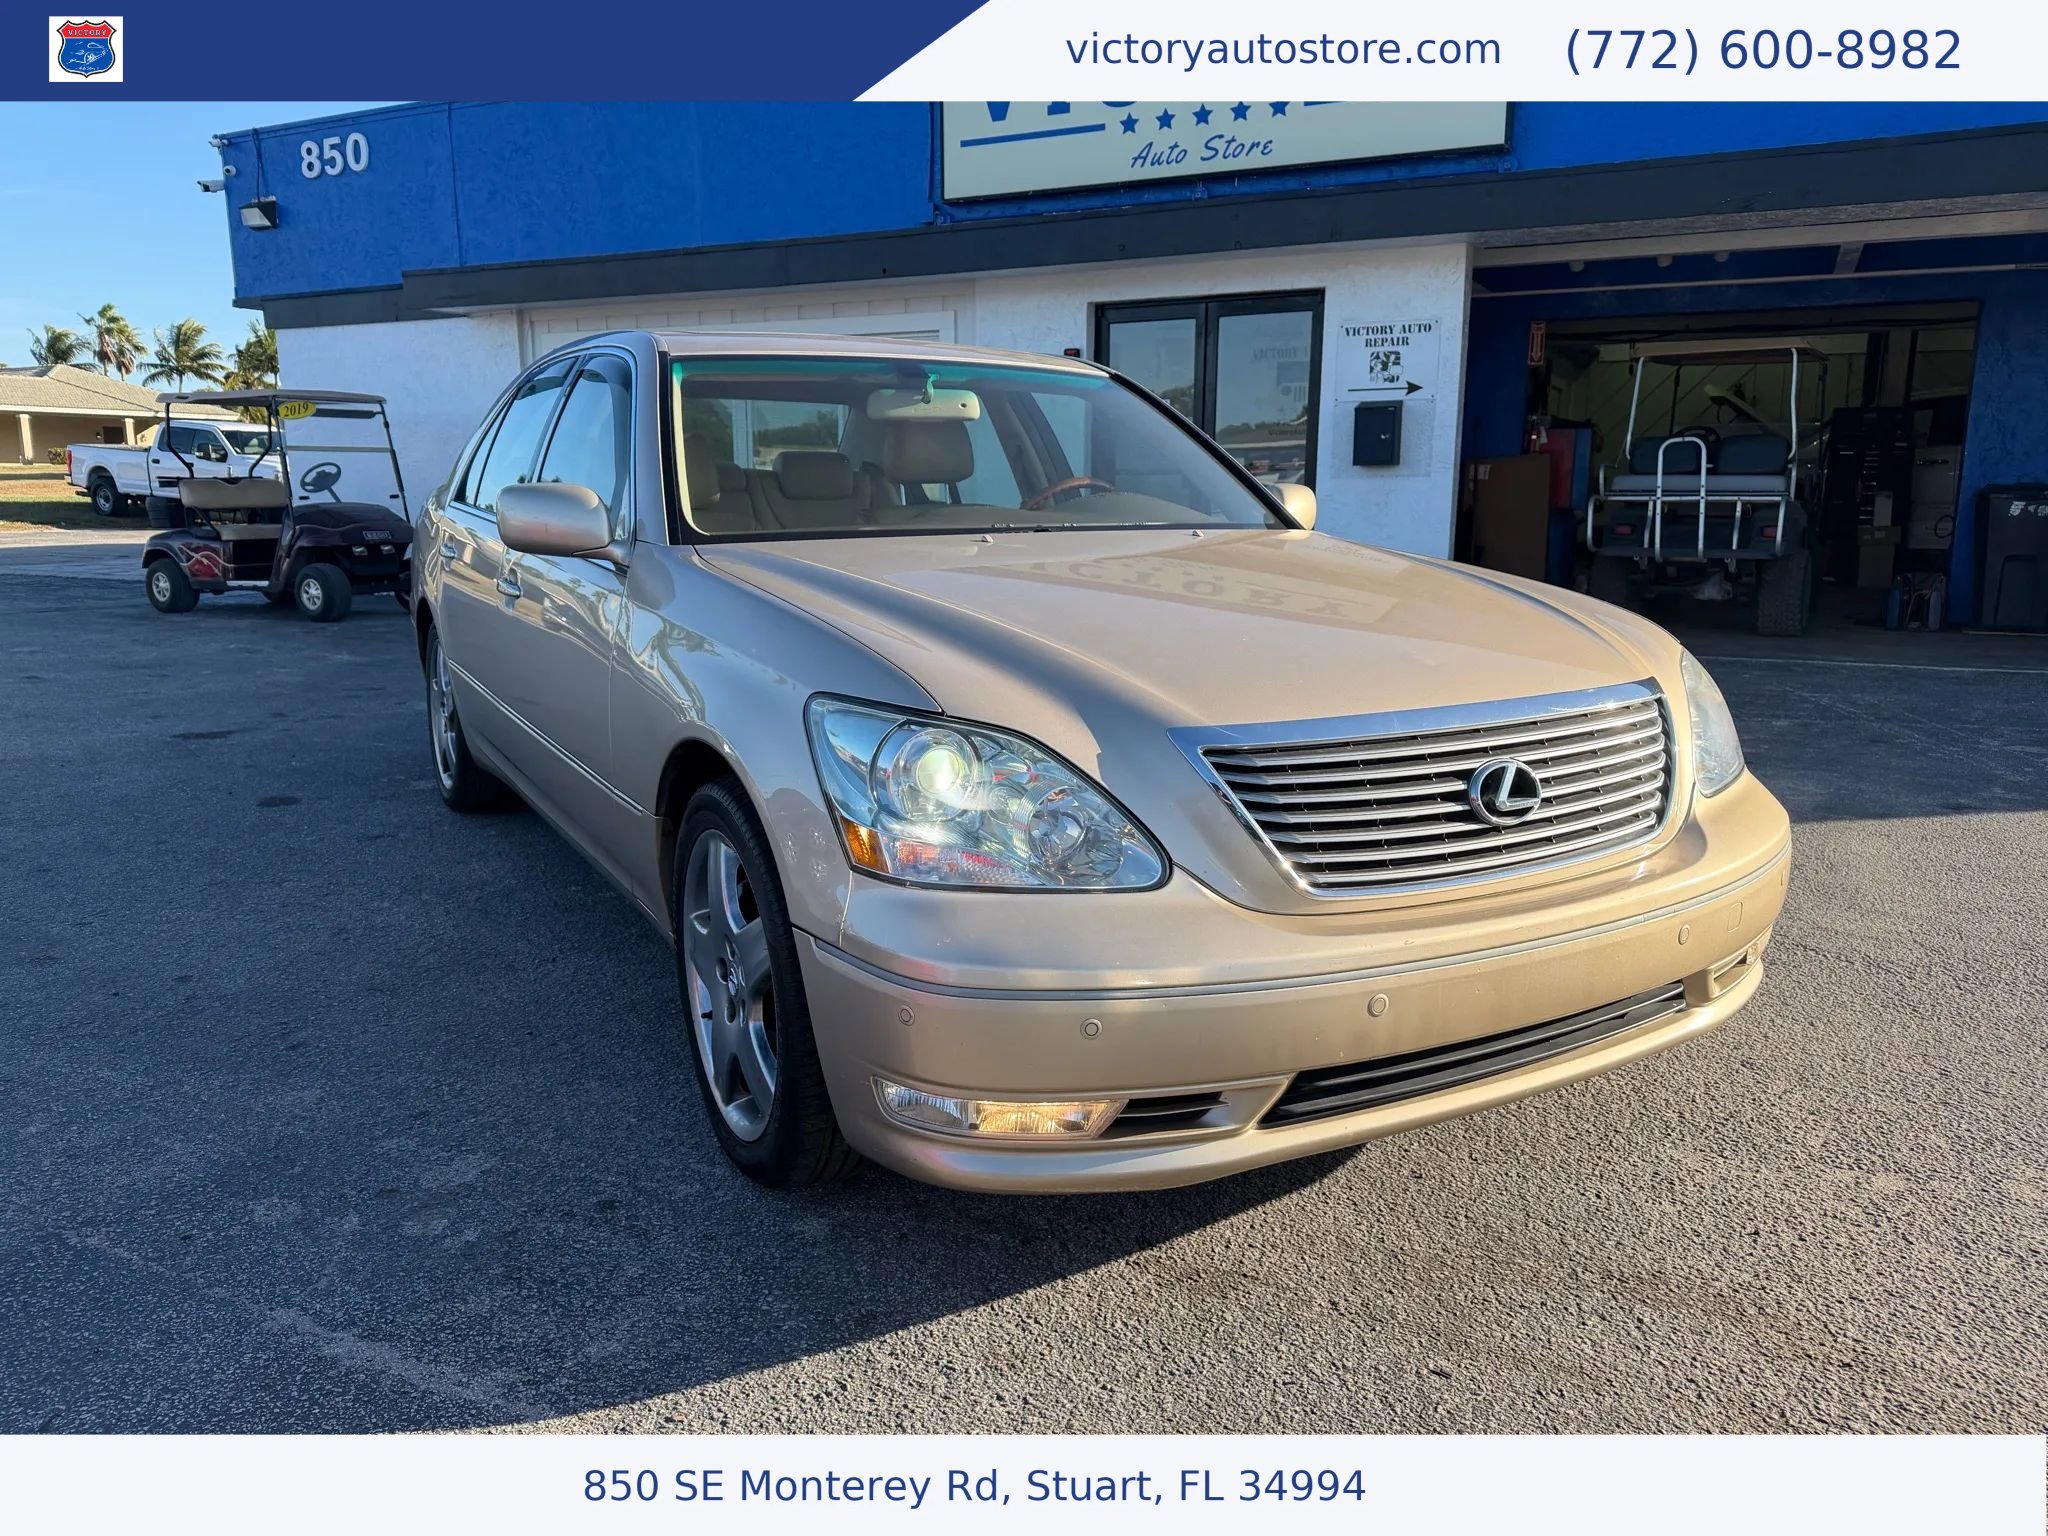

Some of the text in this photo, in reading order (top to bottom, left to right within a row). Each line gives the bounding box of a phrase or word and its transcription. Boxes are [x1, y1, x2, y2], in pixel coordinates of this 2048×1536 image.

[301, 132, 369, 179] 850
[1131, 134, 1274, 169] Auto Store
[1345, 323, 1432, 337] VICTORY AUTO
[1364, 336, 1410, 348] REPAIR
[284, 402, 309, 417] 2019
